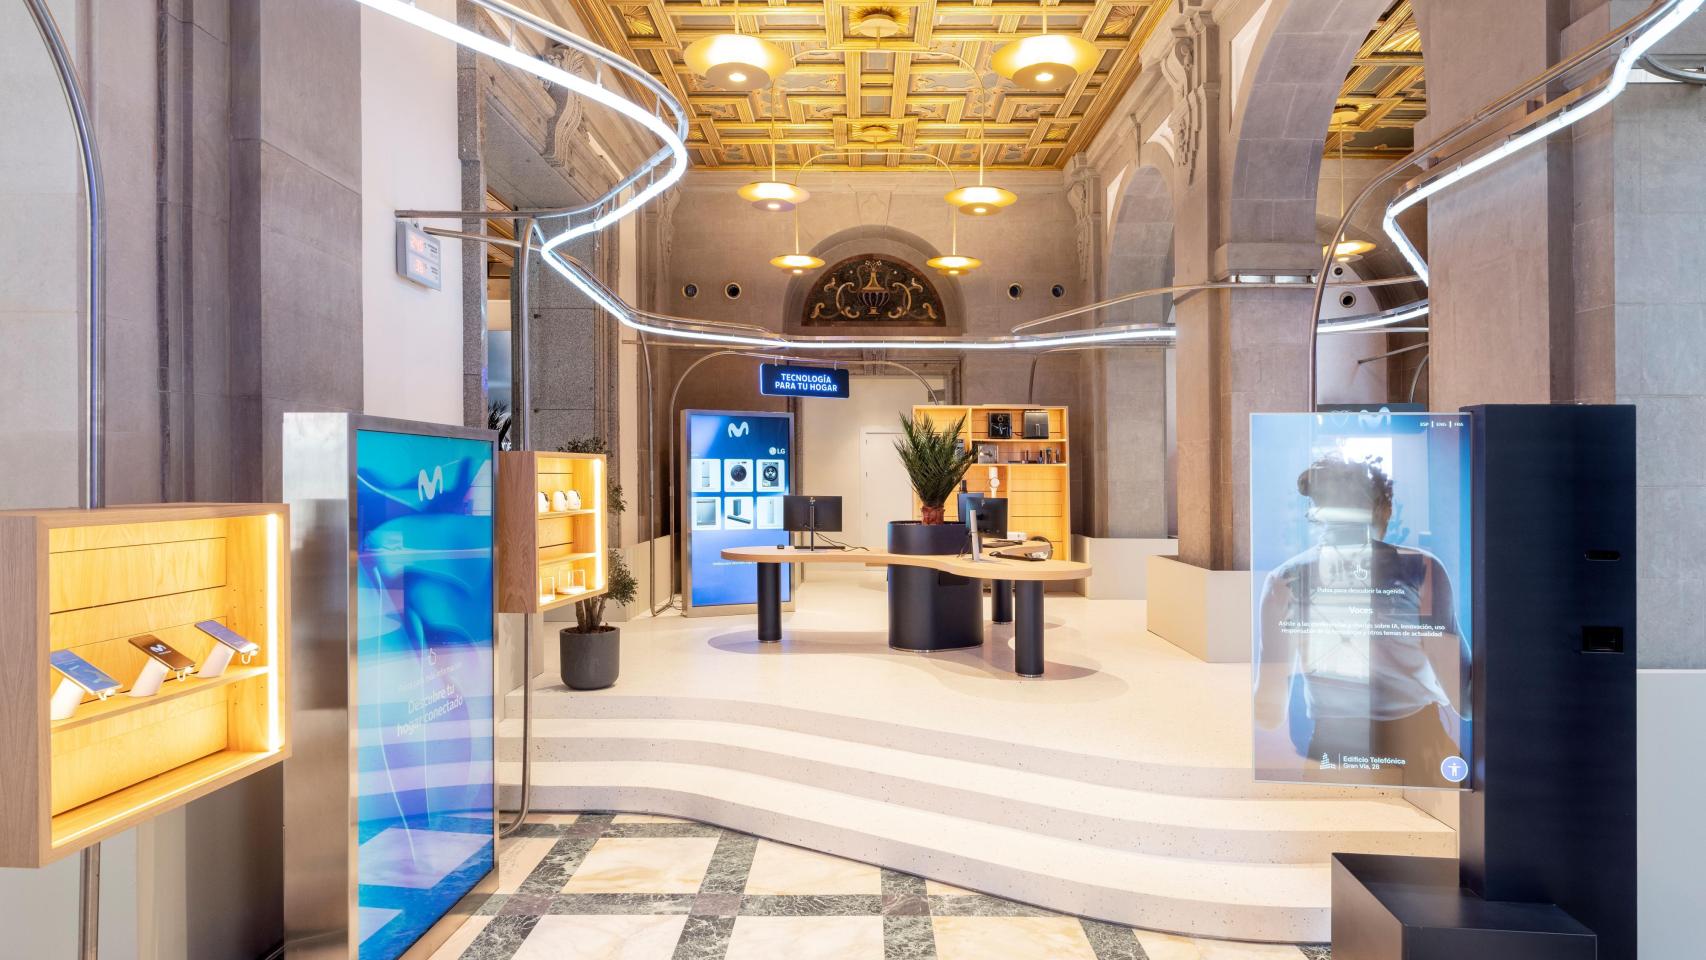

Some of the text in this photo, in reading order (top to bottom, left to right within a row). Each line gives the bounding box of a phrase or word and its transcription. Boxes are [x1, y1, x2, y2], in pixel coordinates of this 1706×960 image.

[781, 373, 832, 383] TECNOLOGÍA
[775, 381, 838, 392] PARA TU HOGAR
[1348, 606, 1374, 615] Voces
[446, 683, 455, 695] tu
[424, 695, 463, 722] conectado
[1343, 755, 1406, 765] Edificio Telefónica
